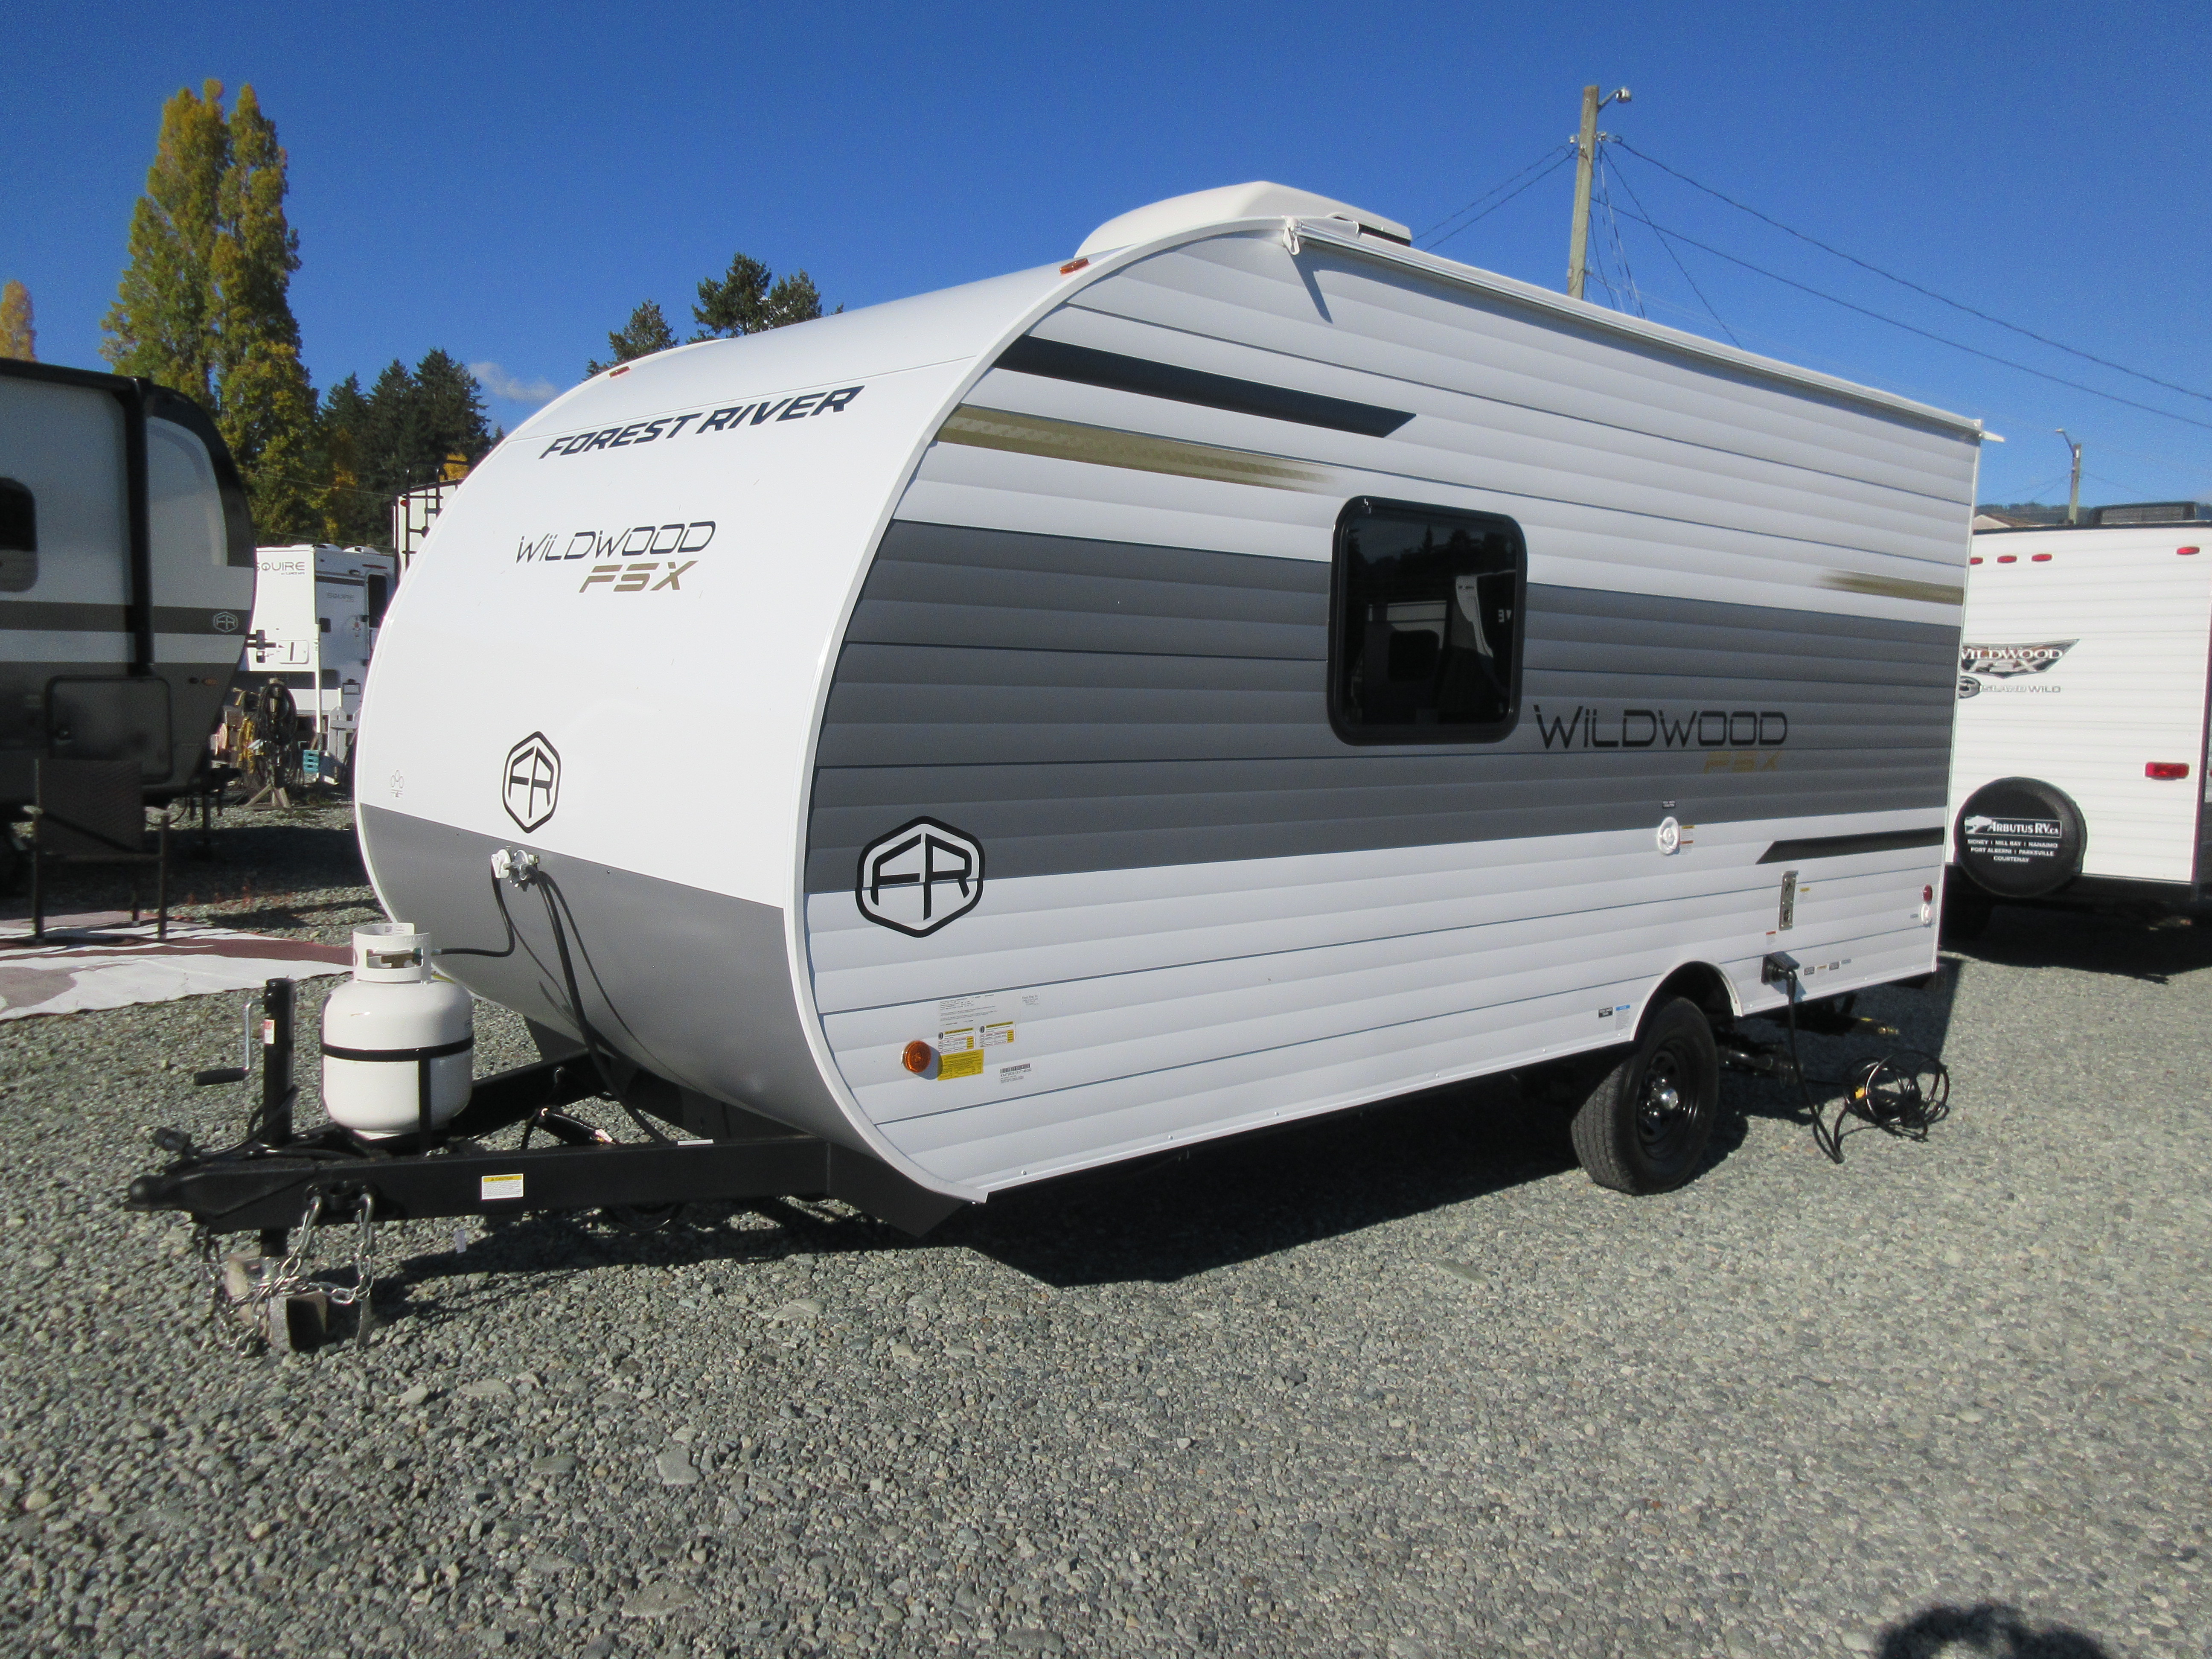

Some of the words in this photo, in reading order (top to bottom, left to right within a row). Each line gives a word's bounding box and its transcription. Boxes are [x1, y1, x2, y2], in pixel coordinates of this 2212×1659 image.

[538, 412, 704, 460] FOREST
[695, 385, 865, 434] RIVER
[516, 521, 716, 563] WILDWOOD
[579, 561, 699, 593] FSX
[1533, 704, 1788, 749] WILDWOOD
[1703, 750, 1784, 774] FSX
